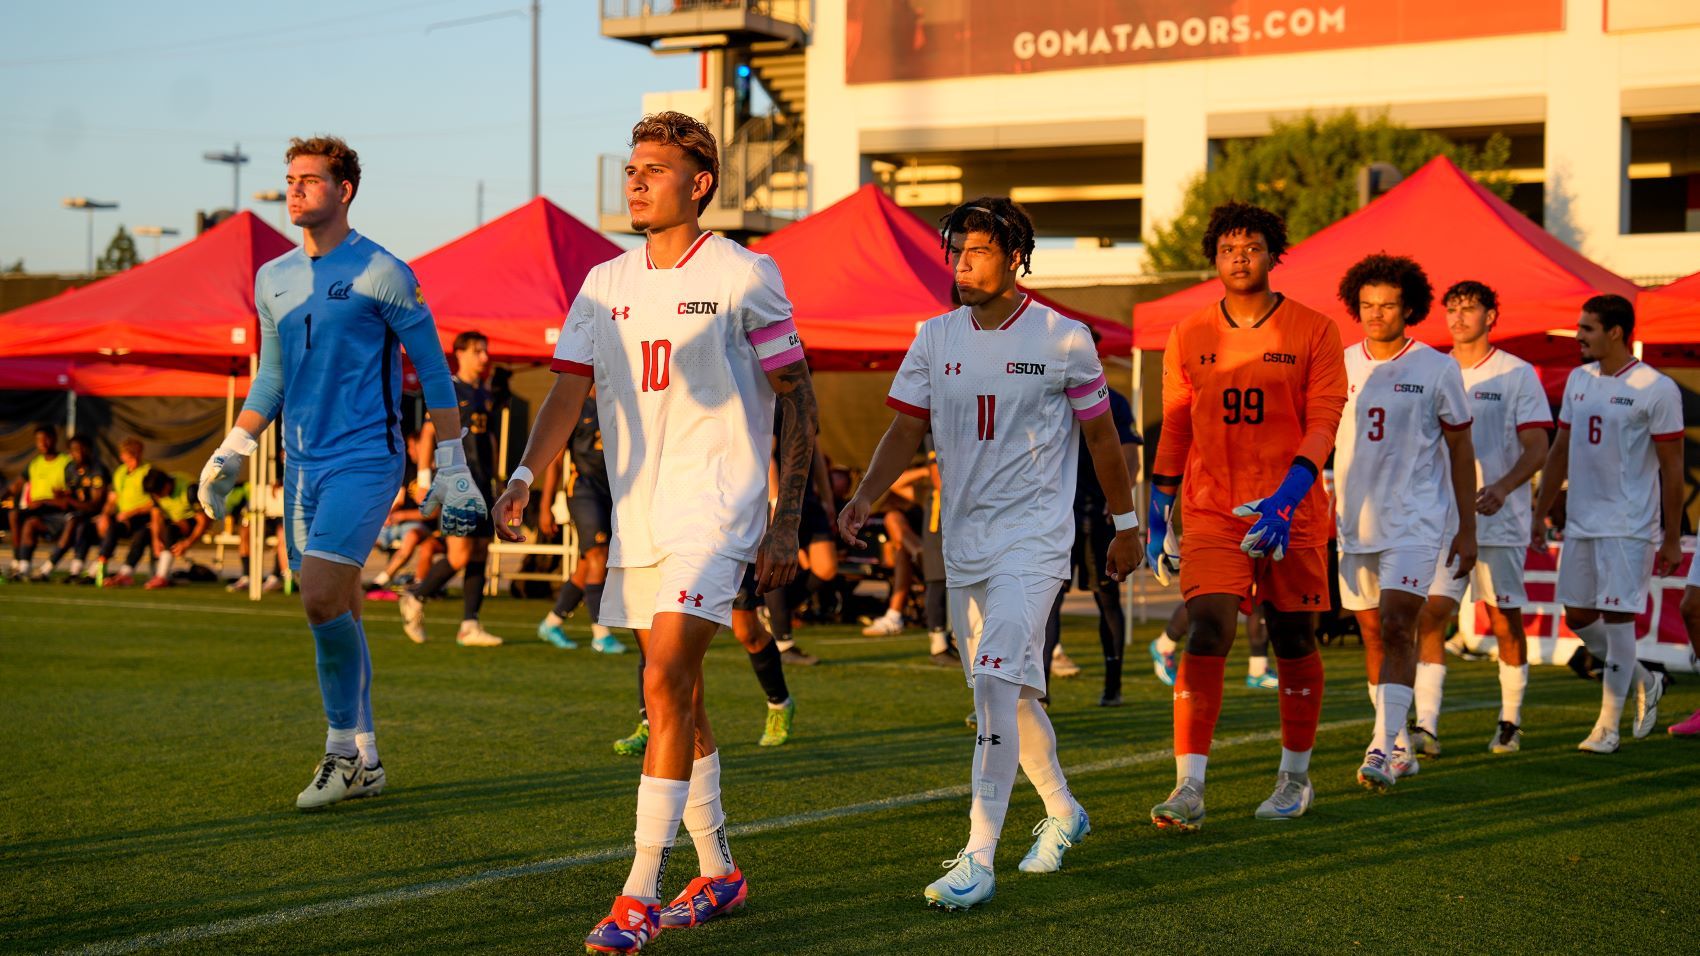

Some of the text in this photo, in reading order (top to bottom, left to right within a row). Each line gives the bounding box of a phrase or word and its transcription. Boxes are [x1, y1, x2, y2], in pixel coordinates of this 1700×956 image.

[1013, 6, 1346, 60] GOMATADORS.COM
[326, 280, 354, 300] Cal
[677, 301, 719, 315] CSUN
[304, 313, 312, 350] 1
[640, 338, 672, 393] 10
[1006, 362, 1047, 376] CSUN
[1263, 352, 1297, 365] CSUN
[1394, 383, 1425, 394] CSUN
[1474, 390, 1503, 401] CSUN
[1610, 395, 1635, 407] CSUN
[976, 394, 996, 441] 11
[1222, 388, 1264, 425] 99
[1367, 406, 1386, 442] 3
[1588, 415, 1603, 446] 6
